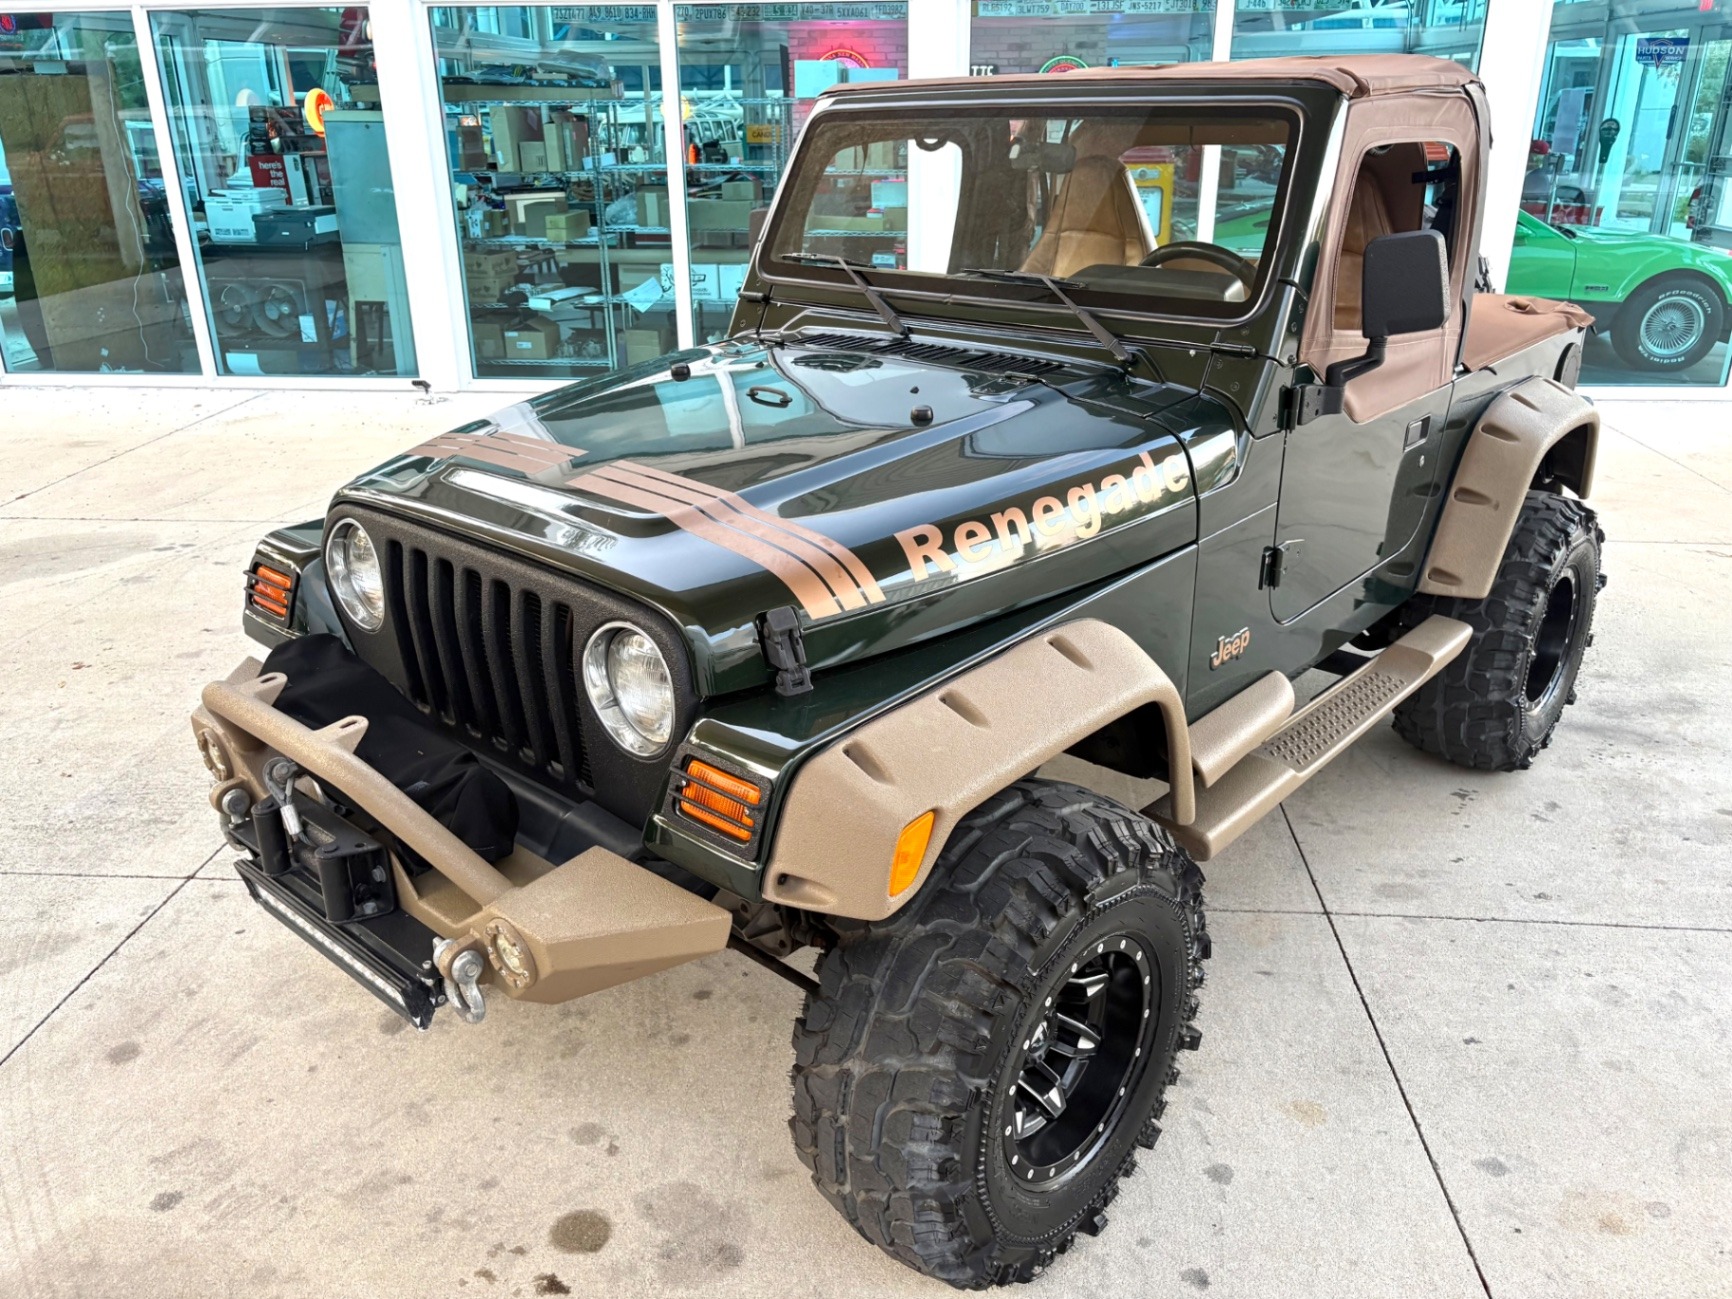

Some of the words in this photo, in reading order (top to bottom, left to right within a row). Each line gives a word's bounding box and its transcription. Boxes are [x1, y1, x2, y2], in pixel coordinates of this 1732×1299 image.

[1637, 46, 1685, 55] HUDSON
[258, 161, 281, 170] here's
[270, 170, 283, 178] the
[894, 450, 1190, 582] Renegade
[1209, 627, 1250, 671] Jeep
